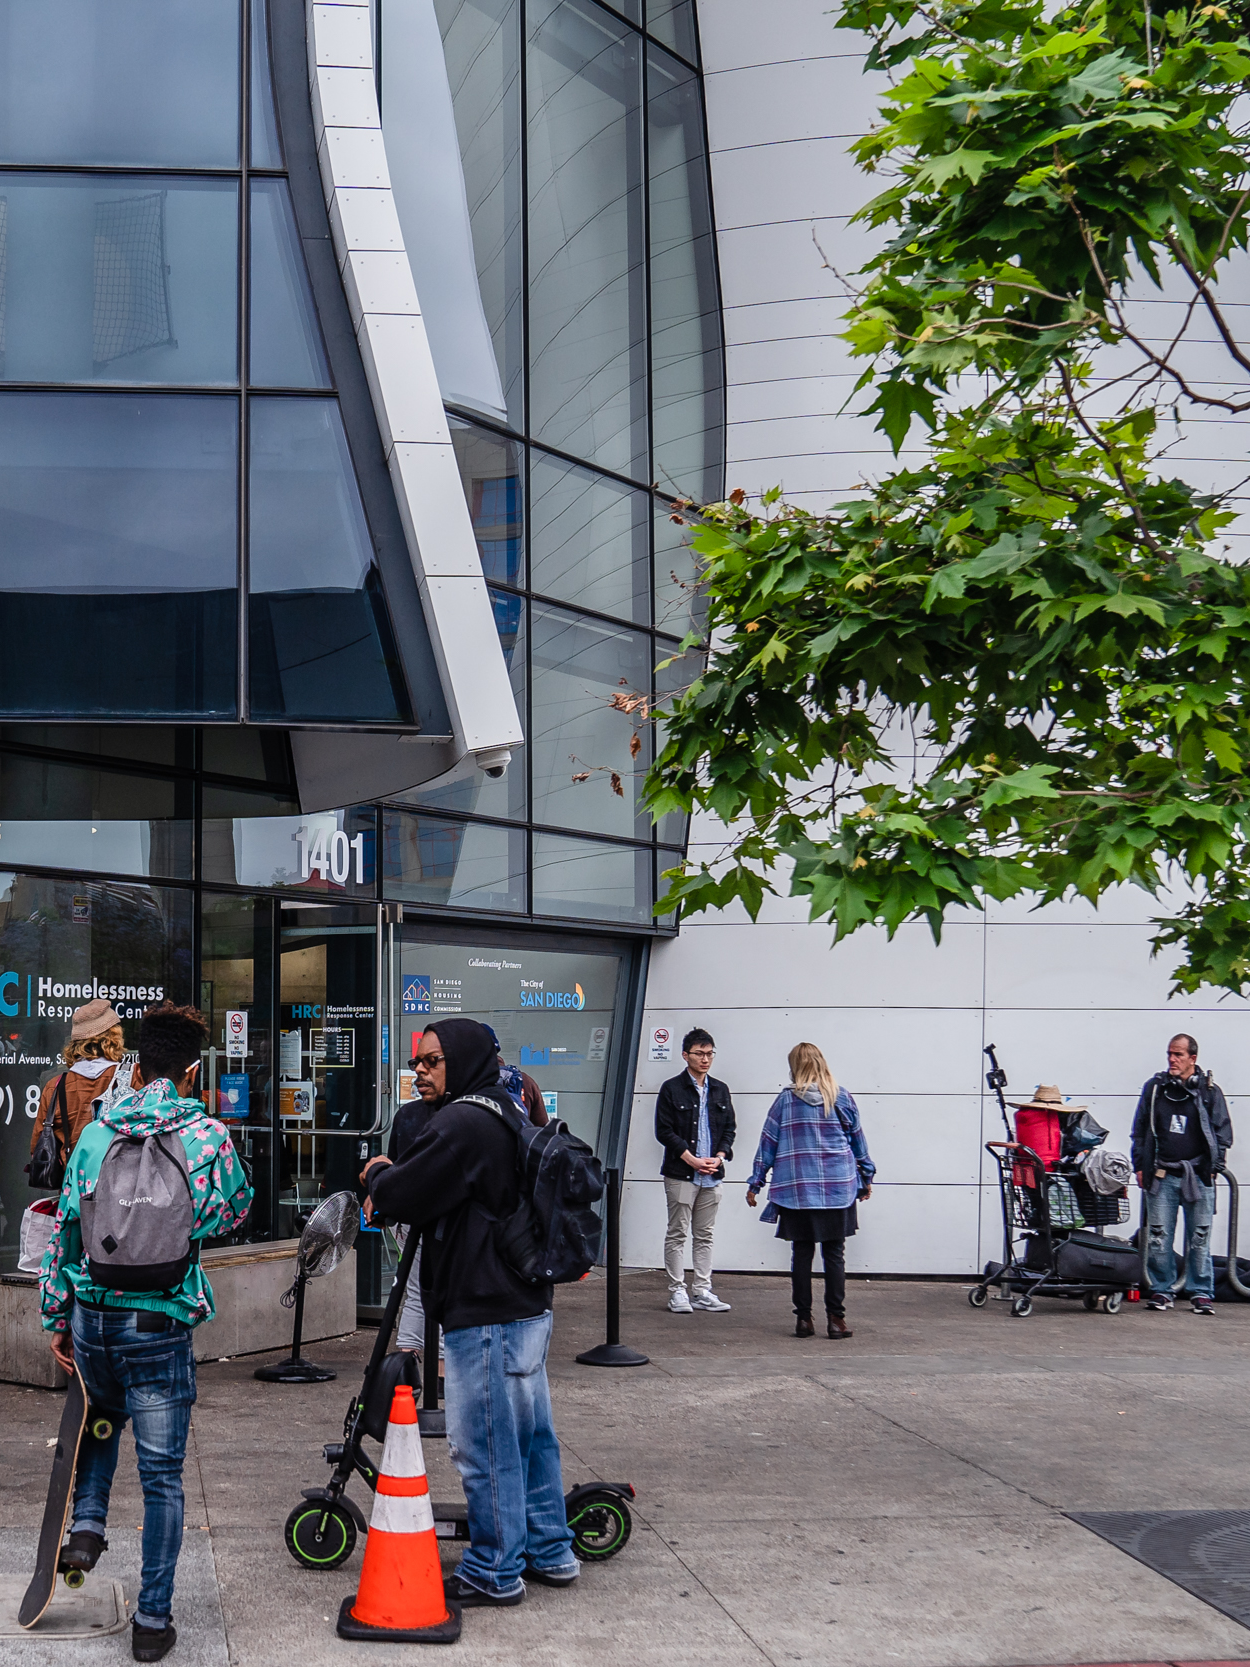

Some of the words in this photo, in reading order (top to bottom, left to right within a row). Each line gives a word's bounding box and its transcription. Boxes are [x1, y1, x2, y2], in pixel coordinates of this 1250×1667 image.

[296, 826, 363, 884] 1401
[468, 958, 502, 970] Collaborating
[502, 960, 522, 969] Partners
[38, 976, 164, 1001] Homelessness
[529, 980, 539, 989] City
[538, 981, 544, 989] of
[520, 991, 543, 1007] SAN
[546, 992, 581, 1008] DIEGO
[38, 1000, 82, 1022] Resp
[292, 1005, 321, 1018] HRC
[405, 1003, 430, 1011] SDHC
[18, 1054, 54, 1066] Avenue,
[56, 1054, 68, 1064] Sa
